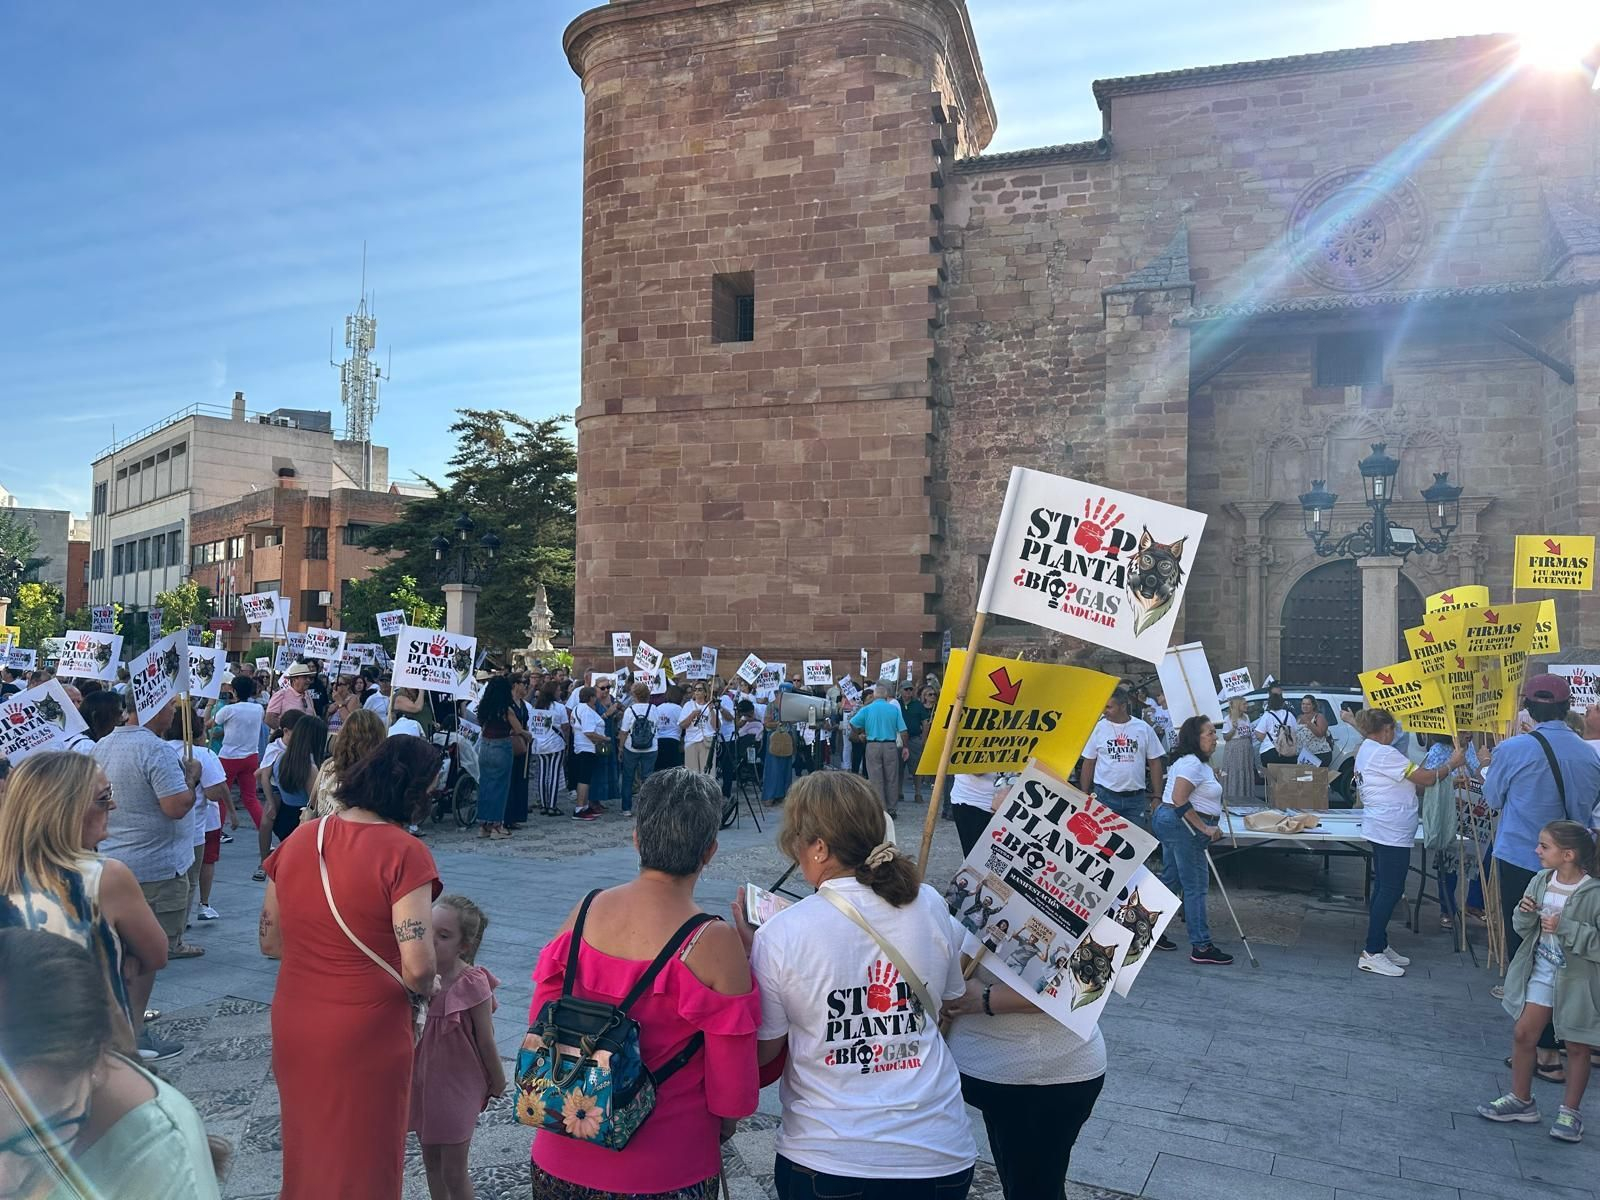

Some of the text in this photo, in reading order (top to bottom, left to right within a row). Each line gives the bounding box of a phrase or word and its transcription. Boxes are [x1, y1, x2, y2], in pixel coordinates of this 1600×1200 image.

[1027, 505, 1137, 561] STOP
[1019, 538, 1126, 589] PLANTA
[1529, 557, 1589, 568] FIRMAS
[1467, 623, 1522, 637] FIRMAS
[64, 640, 96, 651] STOP
[409, 640, 454, 658] STOP
[1414, 639, 1457, 660] FIRMAS
[62, 651, 94, 660] PLANTA
[408, 654, 452, 669] PLANTA
[133, 657, 163, 689] STOP
[1566, 676, 1592, 686] TOP
[135, 670, 165, 701] PLANTA
[1370, 680, 1422, 701] FIRMAS
[1393, 694, 1417, 705] APOYO
[1476, 689, 1503, 705] FIRMAS
[956, 735, 1029, 748] TU APOYO
[1106, 738, 1133, 748] STOP
[1017, 779, 1136, 863] STOP
[1003, 800, 1116, 892] PLANTA
[1009, 873, 1060, 910] MANIFESTACIÓN
[826, 1013, 917, 1042] PLANTA
